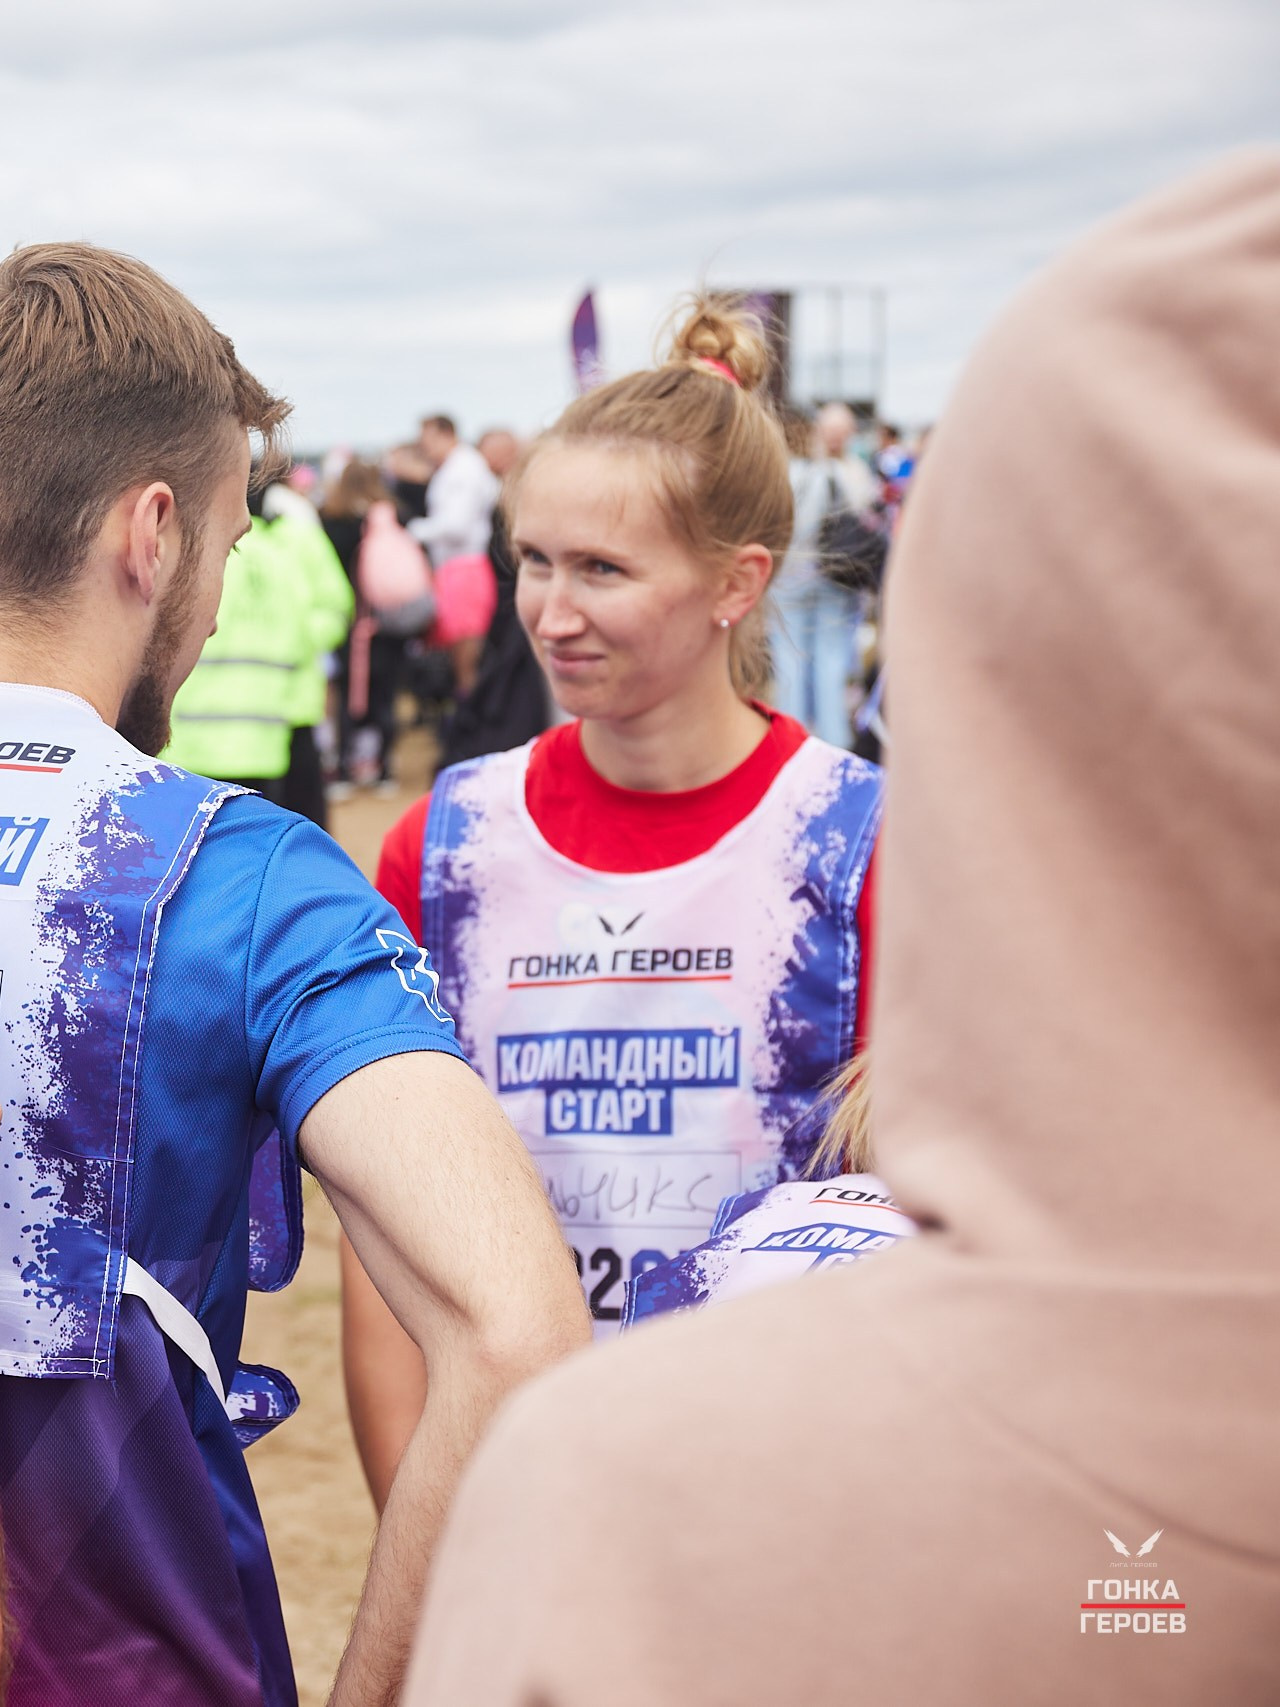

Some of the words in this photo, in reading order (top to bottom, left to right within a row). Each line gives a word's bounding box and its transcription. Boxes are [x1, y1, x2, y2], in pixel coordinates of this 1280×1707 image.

[508, 953, 599, 979] ГОНКА
[611, 948, 733, 972] ГЕРОЕВ
[498, 1026, 736, 1088] КОМАНДНЫЙ
[549, 1088, 665, 1132] СТАРТ
[815, 1187, 899, 1208] ГОН
